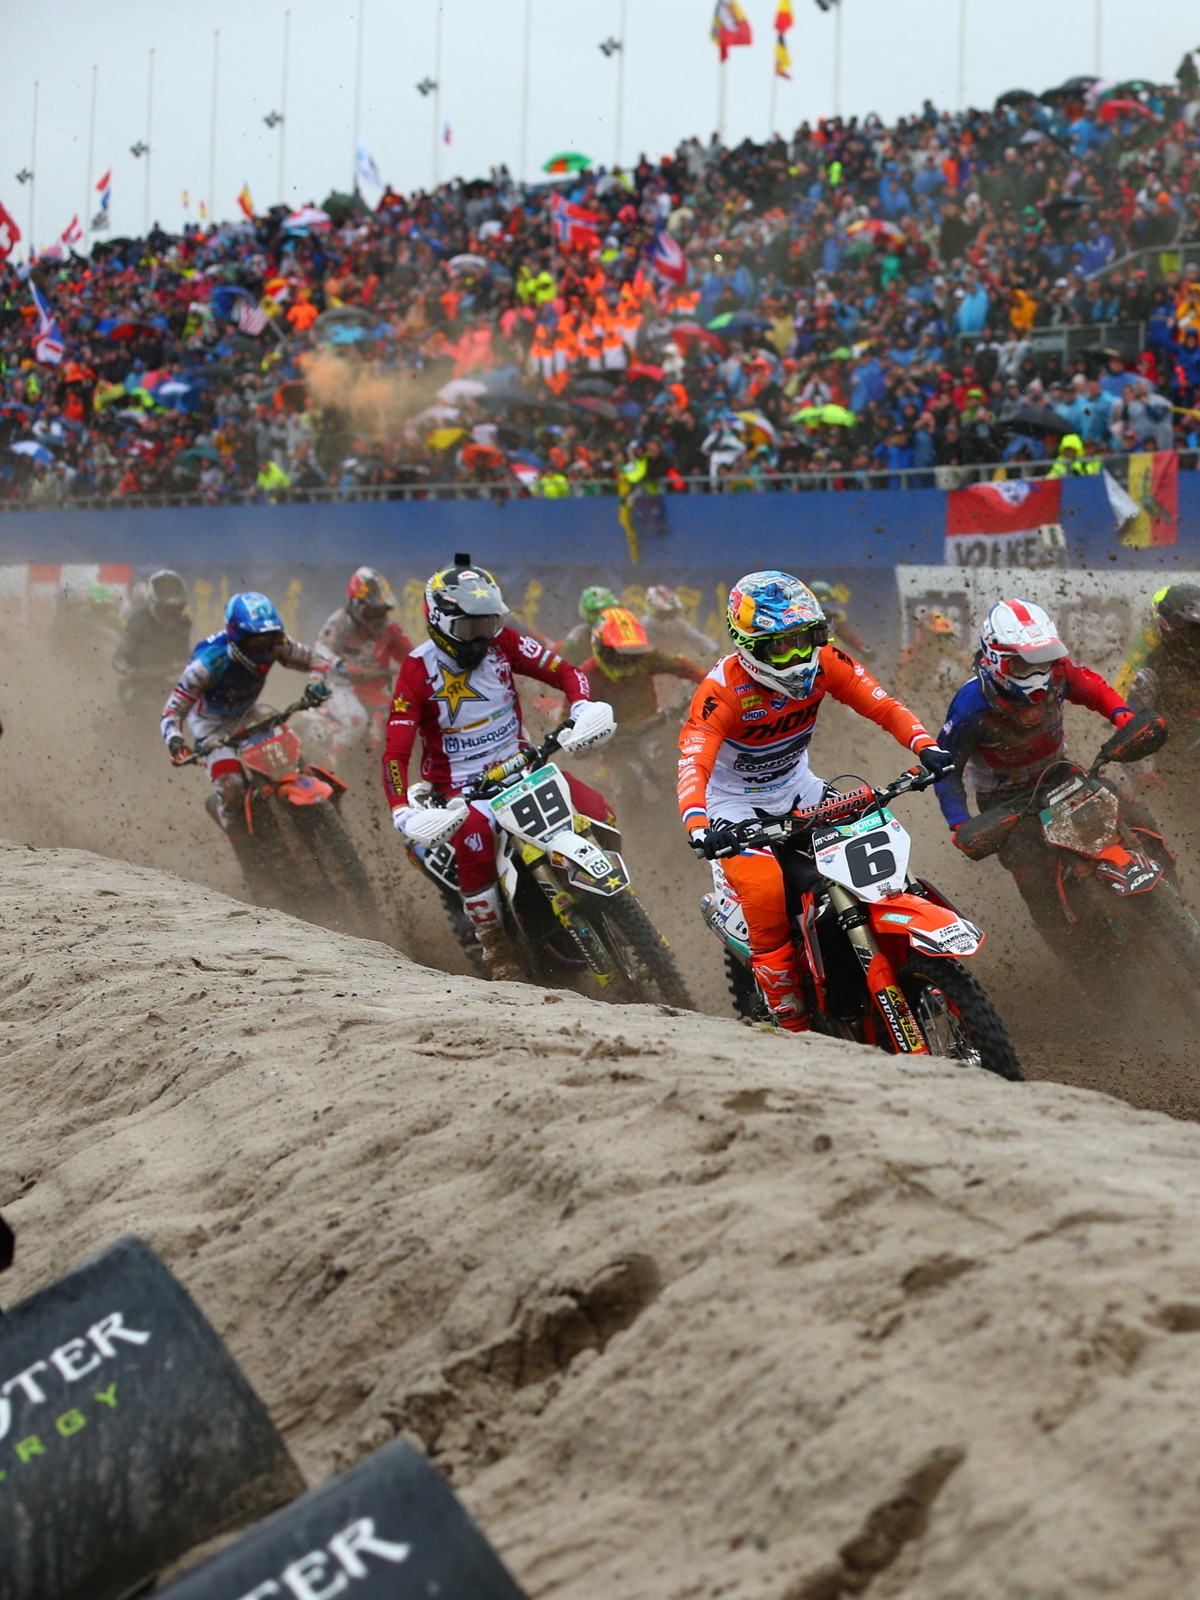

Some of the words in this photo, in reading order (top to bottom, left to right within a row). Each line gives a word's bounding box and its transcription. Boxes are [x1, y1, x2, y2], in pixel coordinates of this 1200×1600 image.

[503, 780, 535, 803] MOTOX
[511, 780, 571, 838] 99
[811, 796, 870, 822] ENTHAL
[845, 831, 896, 888] 6
[877, 994, 908, 1052] DUNLOP
[888, 988, 918, 1048] ACRBIS
[0, 1382, 118, 1482] RGY
